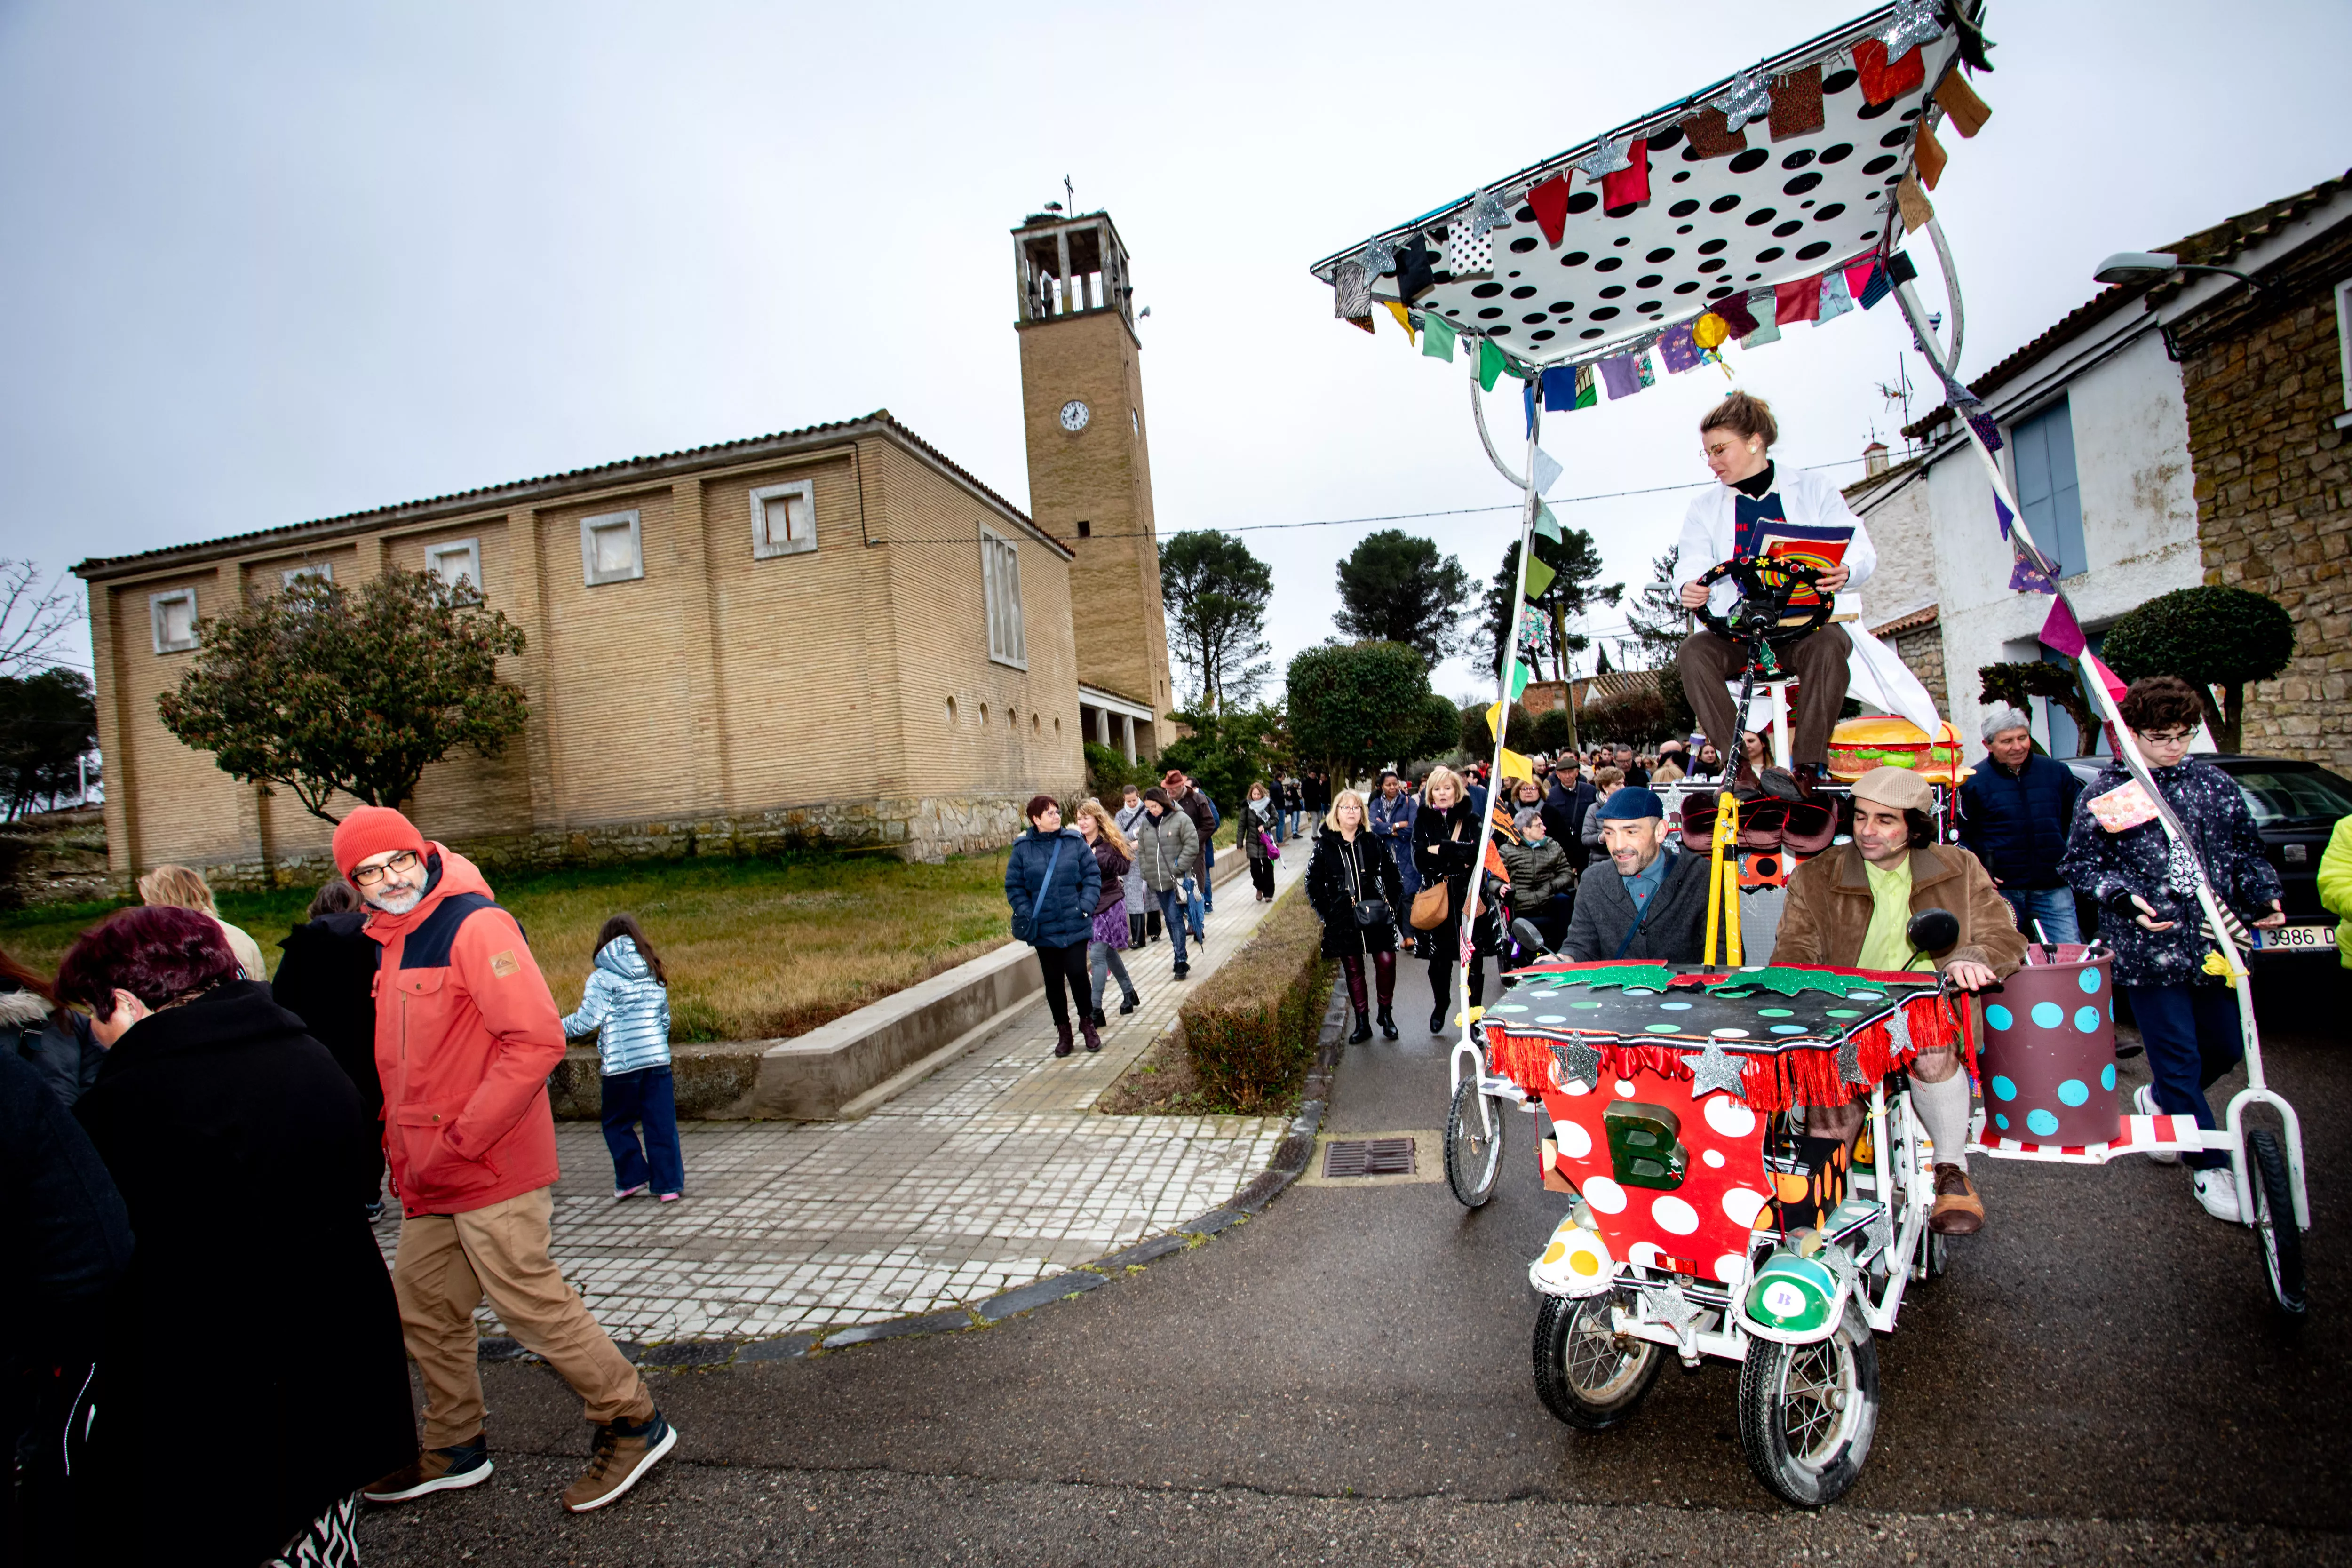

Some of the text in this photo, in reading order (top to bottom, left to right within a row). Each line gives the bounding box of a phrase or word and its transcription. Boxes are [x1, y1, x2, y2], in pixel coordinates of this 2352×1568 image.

[2267, 929, 2314, 946] 3986
[1602, 1104, 1688, 1190] B
[1777, 1292, 1791, 1305] B
